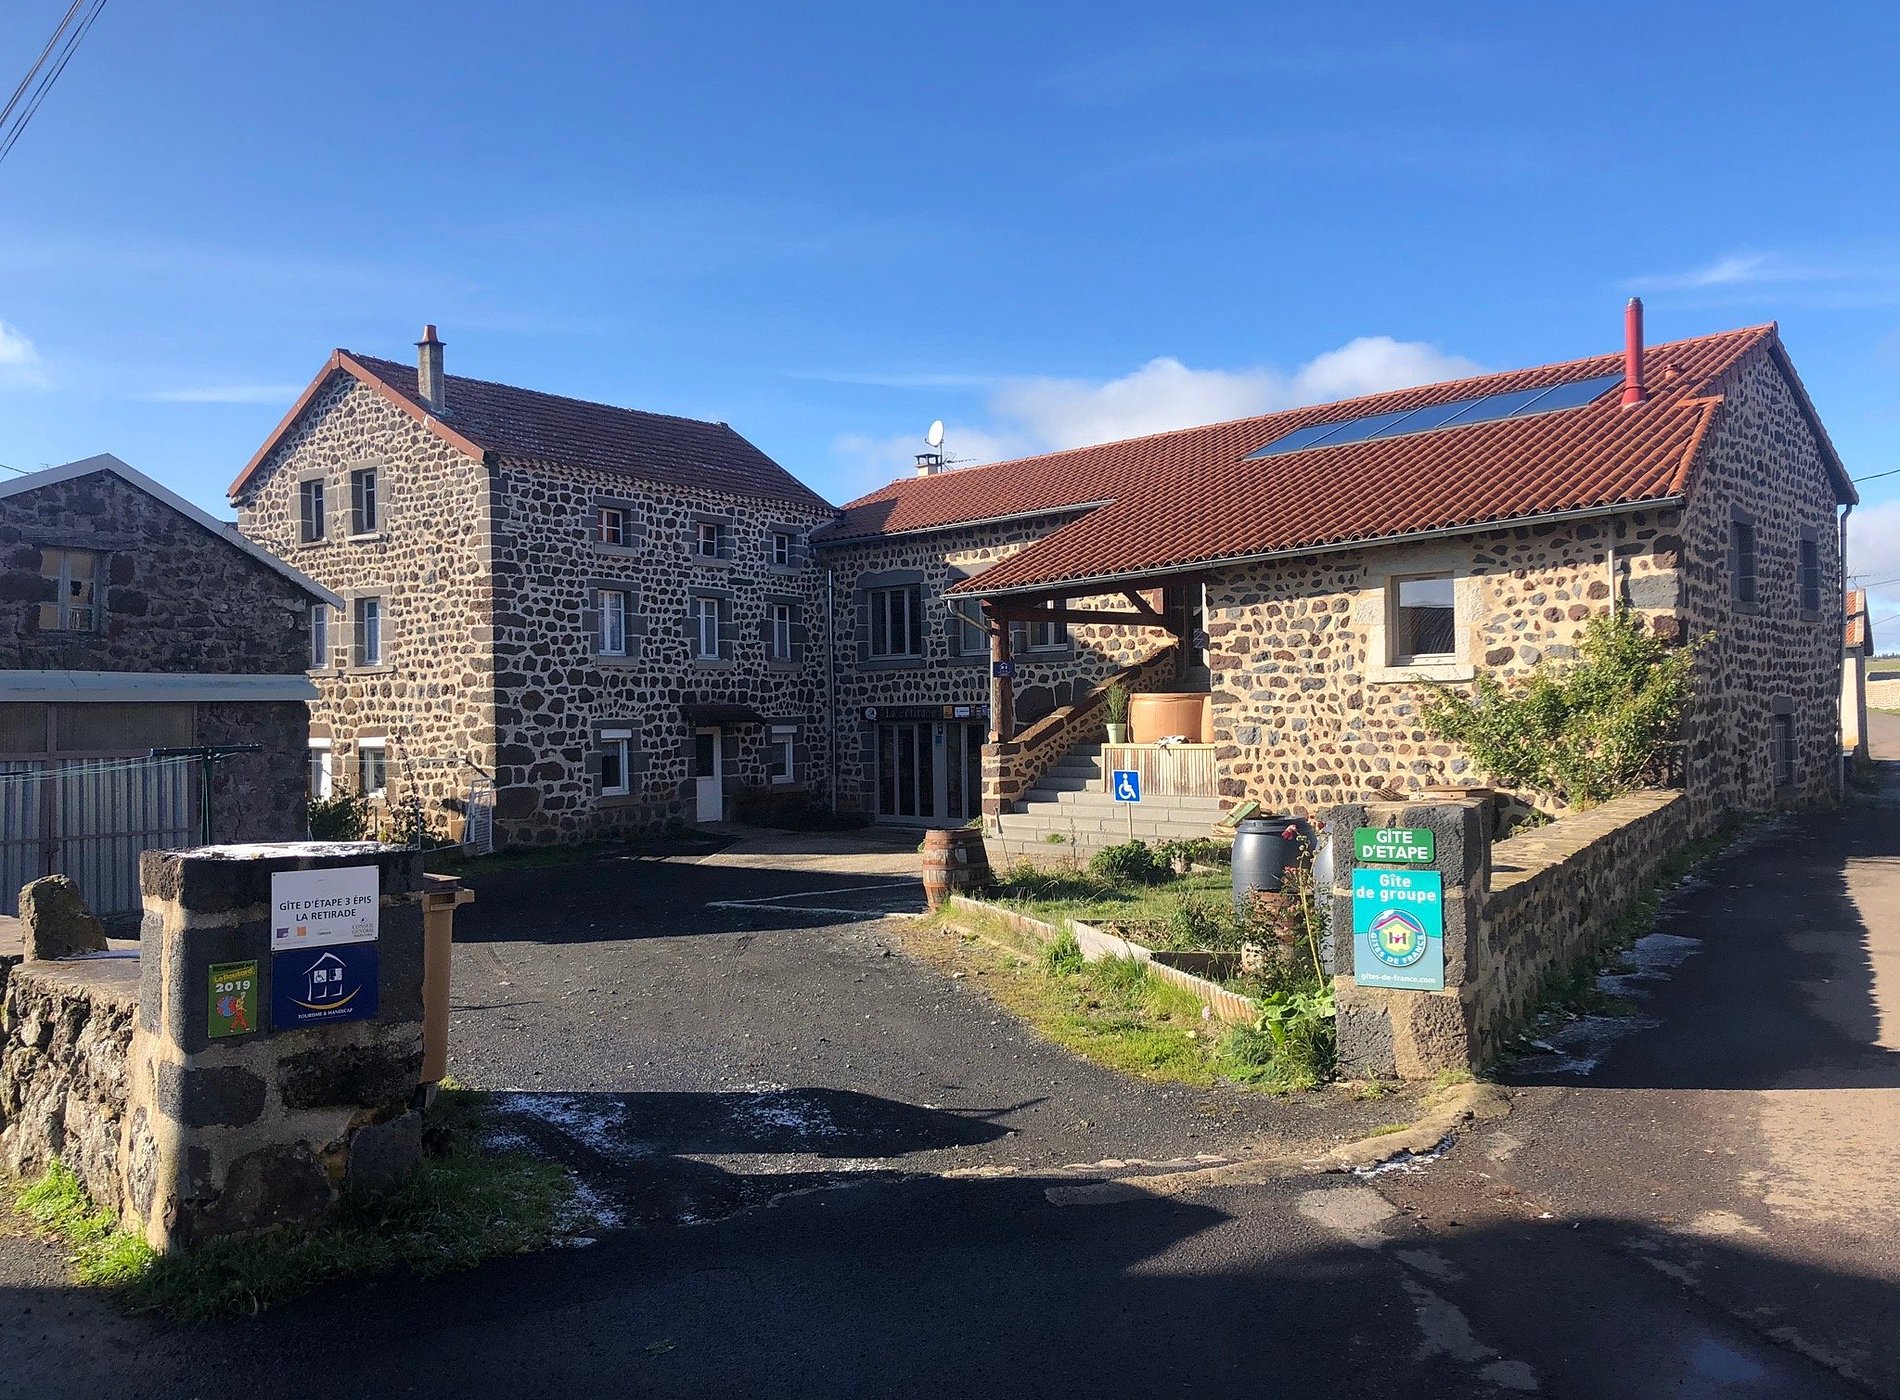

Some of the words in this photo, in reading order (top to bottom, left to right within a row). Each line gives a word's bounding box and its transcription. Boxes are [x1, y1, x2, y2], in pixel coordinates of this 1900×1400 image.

[1362, 845, 1428, 860] D'ETAPE
[1379, 873, 1411, 888] Gîte
[1356, 886, 1375, 899] de
[1380, 889, 1436, 904] groupe
[279, 900, 301, 911] GÎTE
[304, 897, 343, 909] D'ÉTAPE
[345, 896, 351, 906] 3
[353, 895, 372, 905] ÉPIS
[296, 912, 308, 922] LA
[311, 909, 357, 920] RETIRADE
[1387, 956, 1400, 965] DE
[1402, 935, 1424, 964] FRANCE
[1361, 973, 1436, 984] gites-de-france.com
[215, 980, 251, 993] 2019
[298, 1011, 323, 1019] TOURISME
[327, 1008, 353, 1016] HANDICAP
